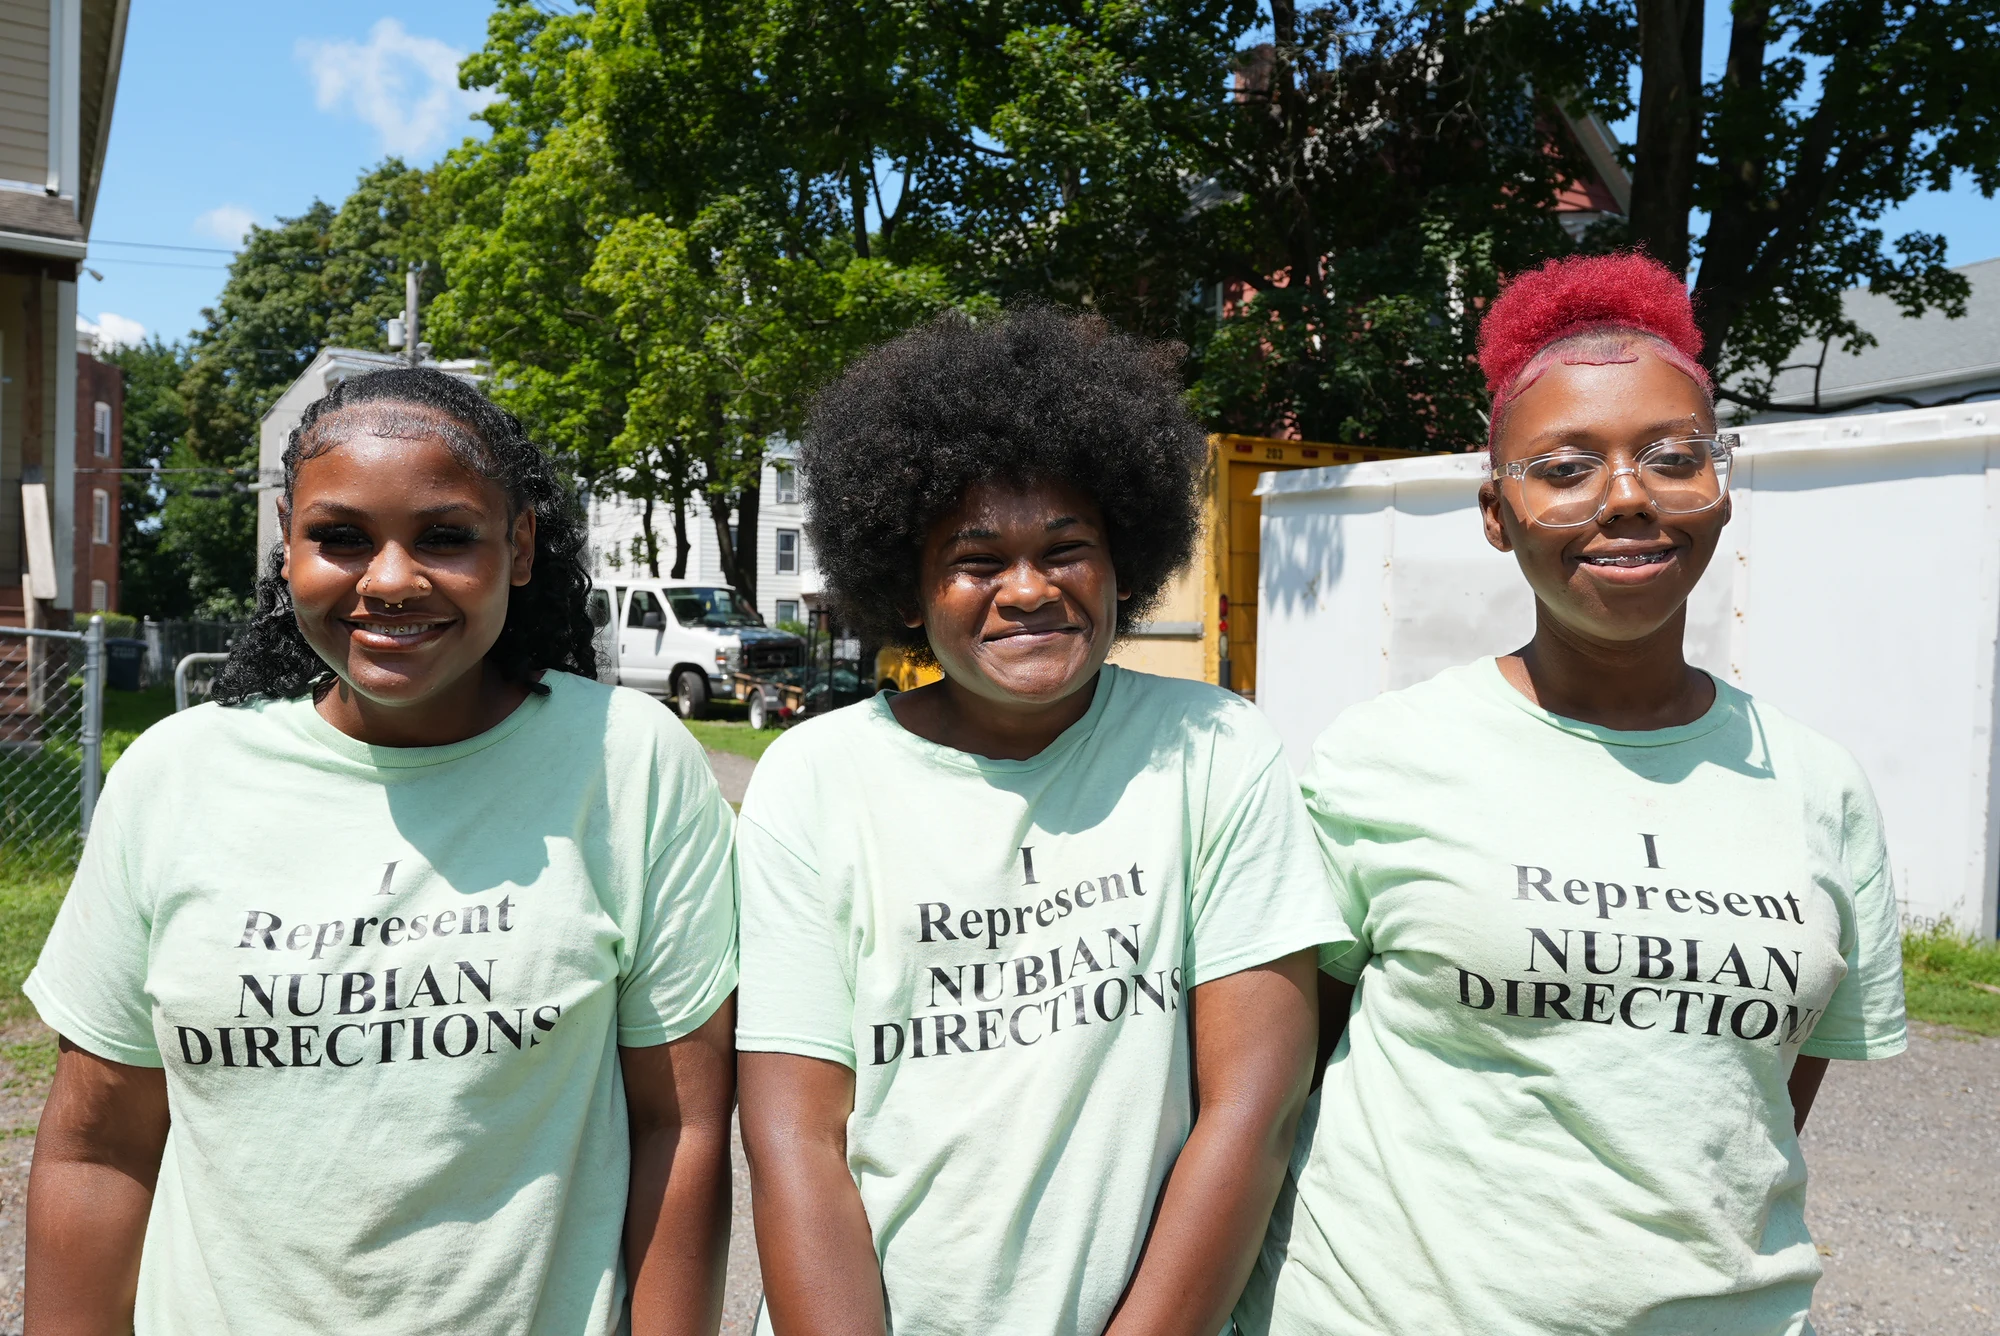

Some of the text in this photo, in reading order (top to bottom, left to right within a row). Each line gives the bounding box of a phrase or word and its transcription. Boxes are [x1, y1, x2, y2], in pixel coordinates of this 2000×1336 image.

[373, 859, 403, 896] I
[1017, 845, 1040, 886] I
[1637, 832, 1665, 869] I
[917, 861, 1147, 950] Represent
[1511, 864, 1805, 925] Represent
[234, 894, 516, 960] Represent
[235, 959, 499, 1018] NUBIAN
[927, 923, 1141, 1008] NUBIAN
[1525, 927, 1803, 996] NUBIAN
[174, 1004, 561, 1068] DIRECTIONS
